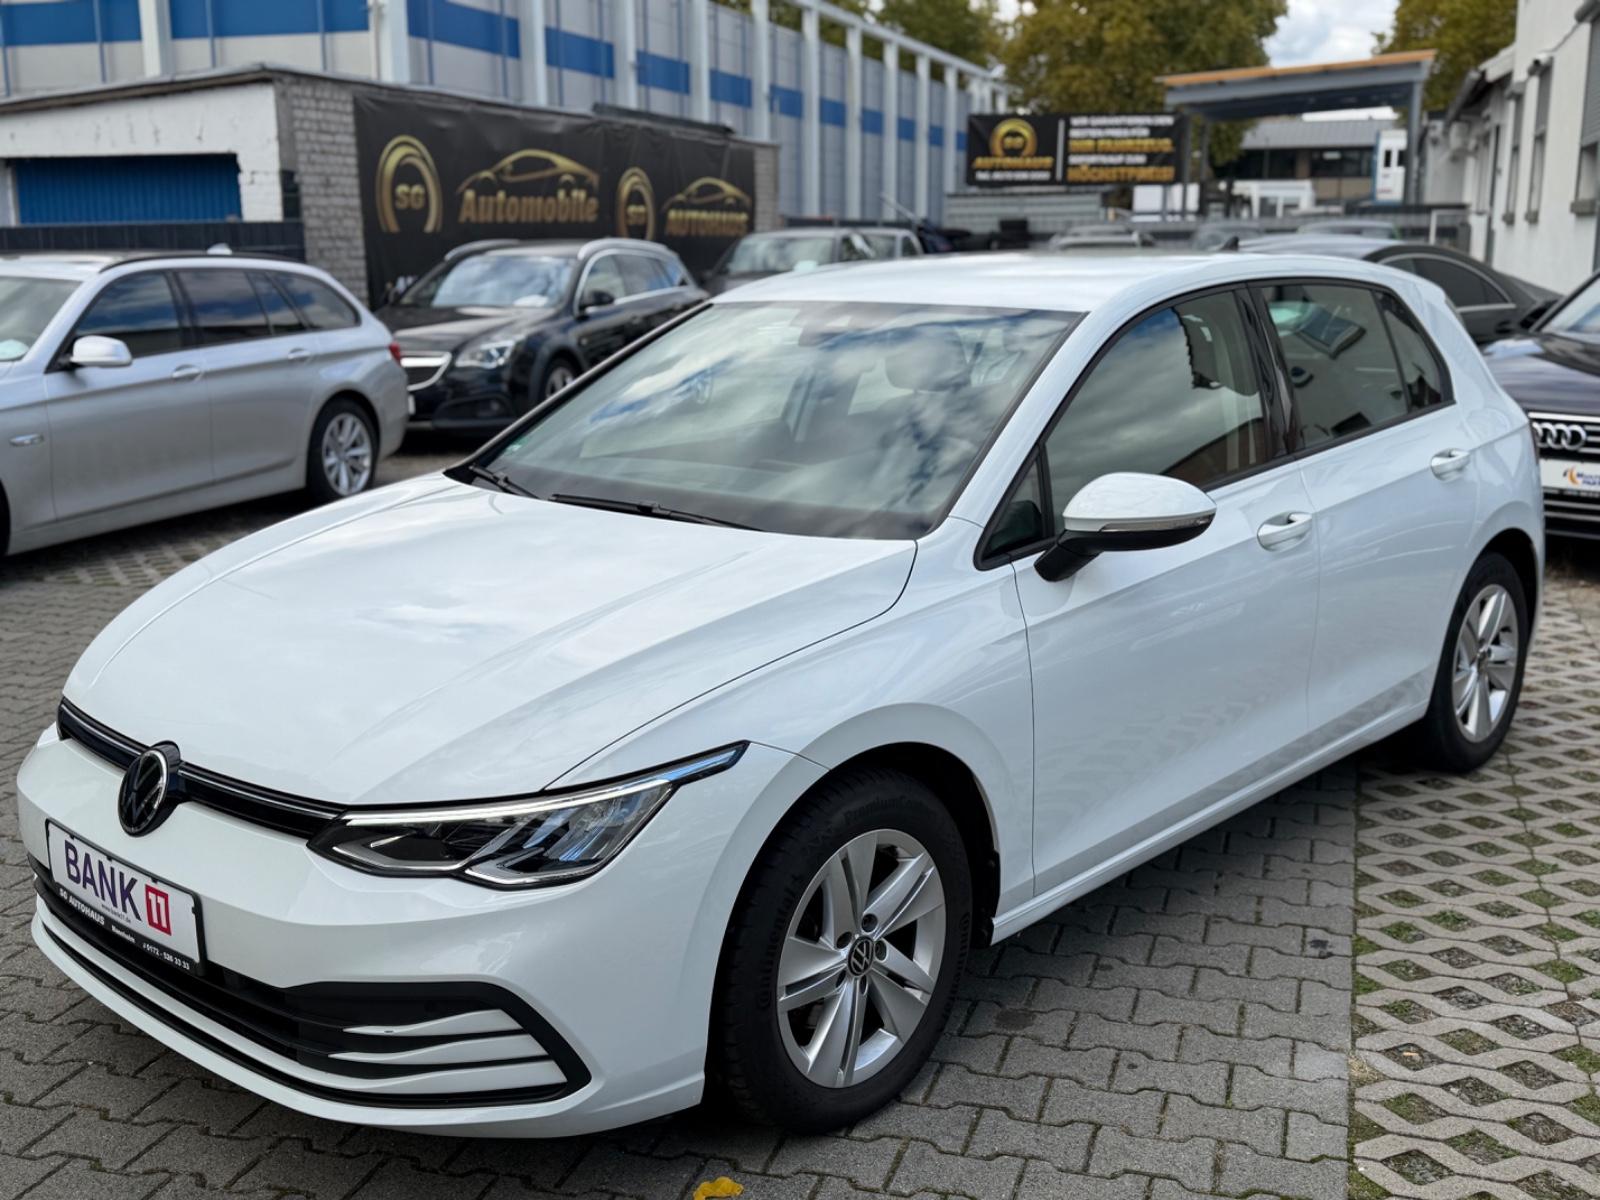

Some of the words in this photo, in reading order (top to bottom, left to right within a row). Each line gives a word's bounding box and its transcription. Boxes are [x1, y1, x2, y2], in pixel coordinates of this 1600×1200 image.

[394, 183, 425, 211] SG
[459, 188, 600, 224] Automobile
[665, 209, 750, 237] AUTOHAUS
[64, 839, 142, 922] BANK
[148, 891, 168, 930] 11
[59, 887, 68, 900] SG
[69, 895, 105, 926] AUTOHAUS
